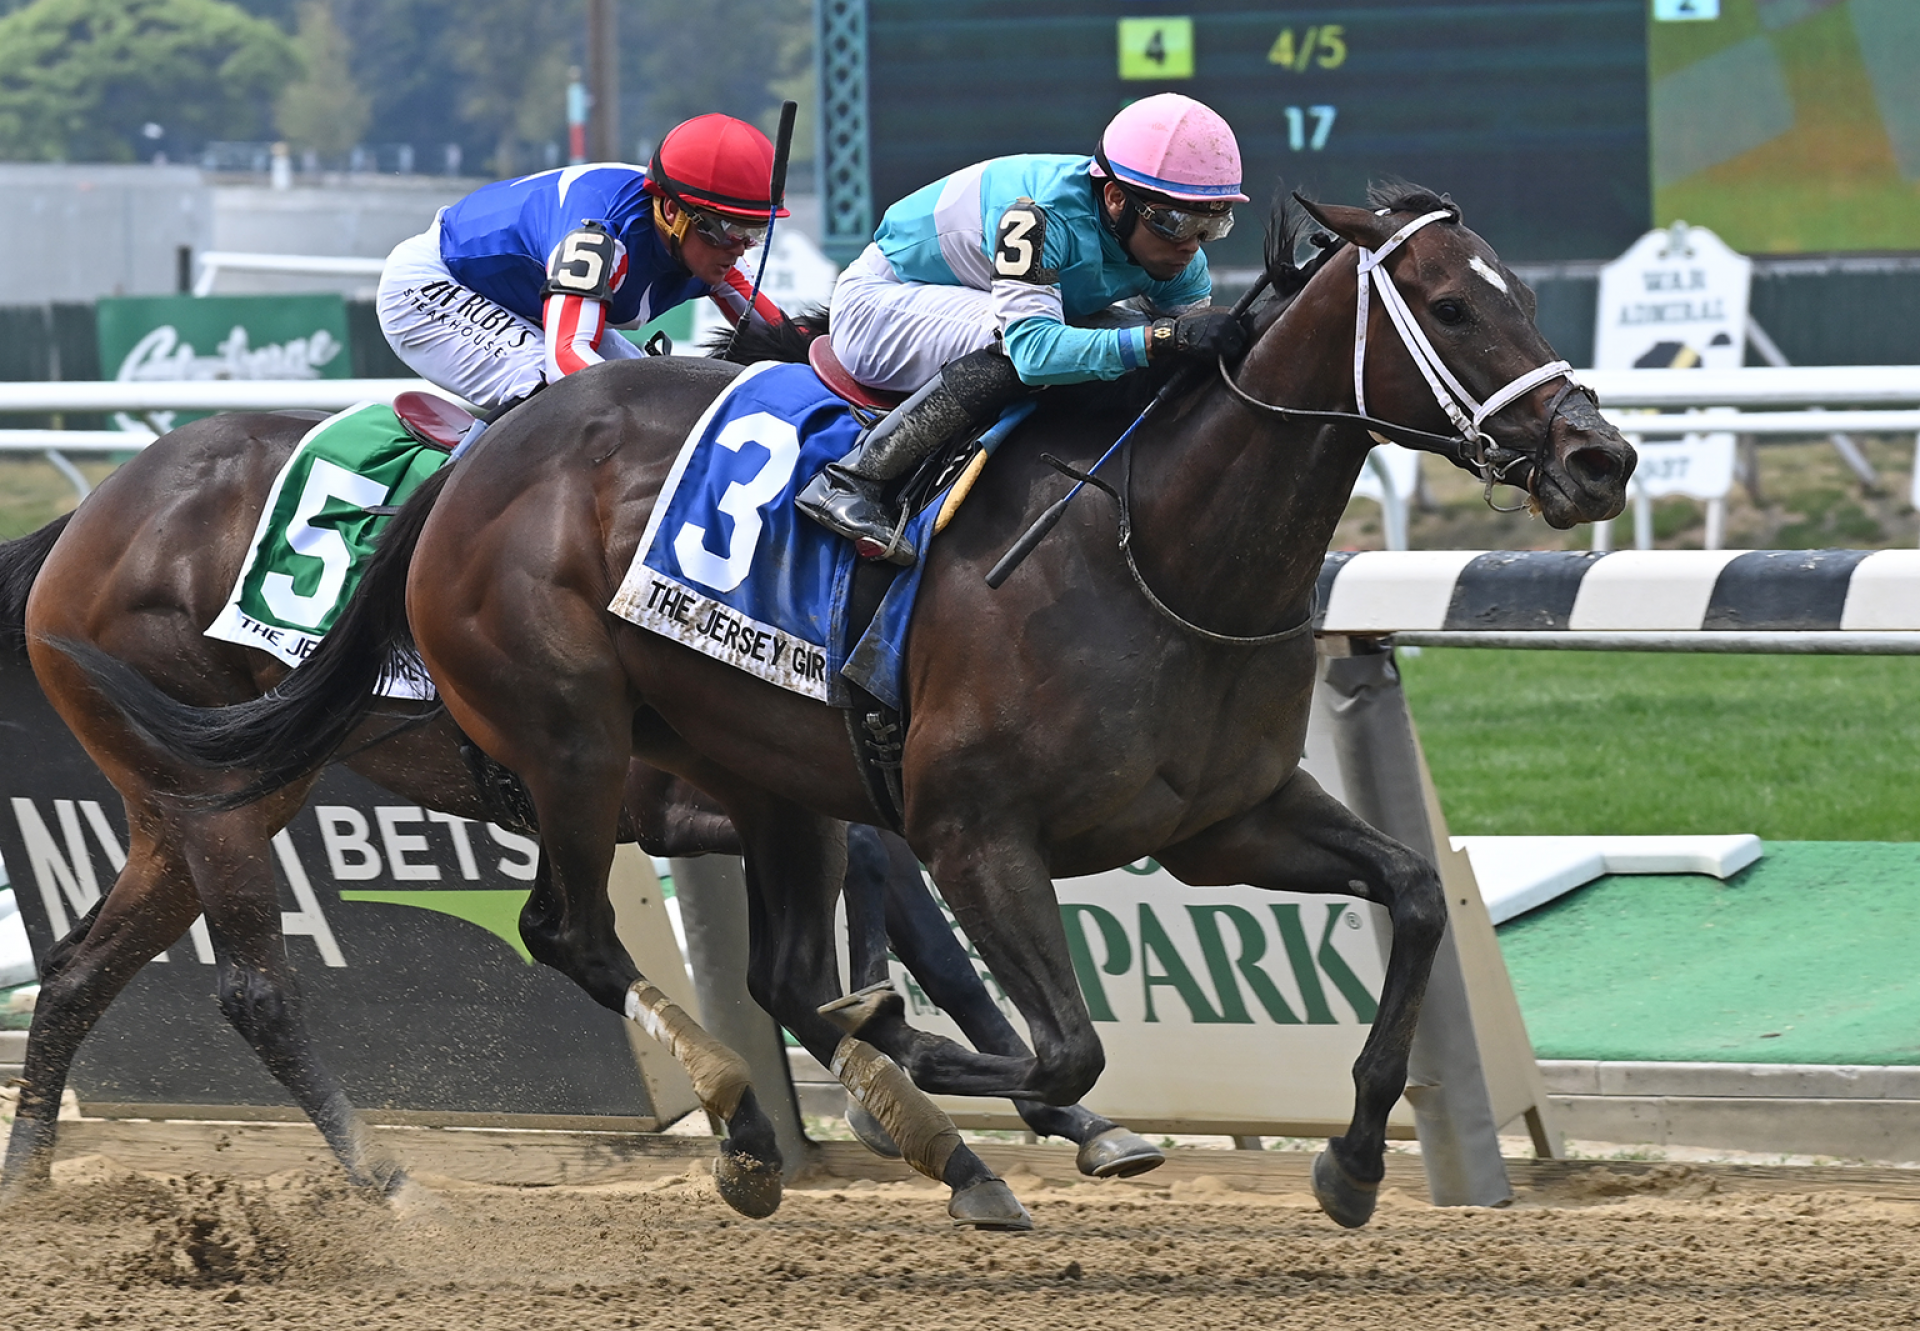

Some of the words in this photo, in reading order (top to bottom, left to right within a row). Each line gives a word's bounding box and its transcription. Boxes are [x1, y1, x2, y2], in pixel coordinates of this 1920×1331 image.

[1144, 29, 1167, 65] 4
[1267, 24, 1347, 73] 4/5
[1284, 105, 1337, 151] 17
[558, 233, 604, 290] 5
[995, 210, 1036, 276] 3
[403, 287, 505, 358] STEAKHOUSE
[456, 292, 537, 348] RUBY'S
[673, 411, 800, 592] 3
[259, 456, 390, 629] 5
[241, 616, 285, 647] THE
[646, 580, 697, 626] THE
[696, 609, 787, 666] JERSEY
[792, 647, 827, 682] GIR
[315, 805, 540, 881] BETS
